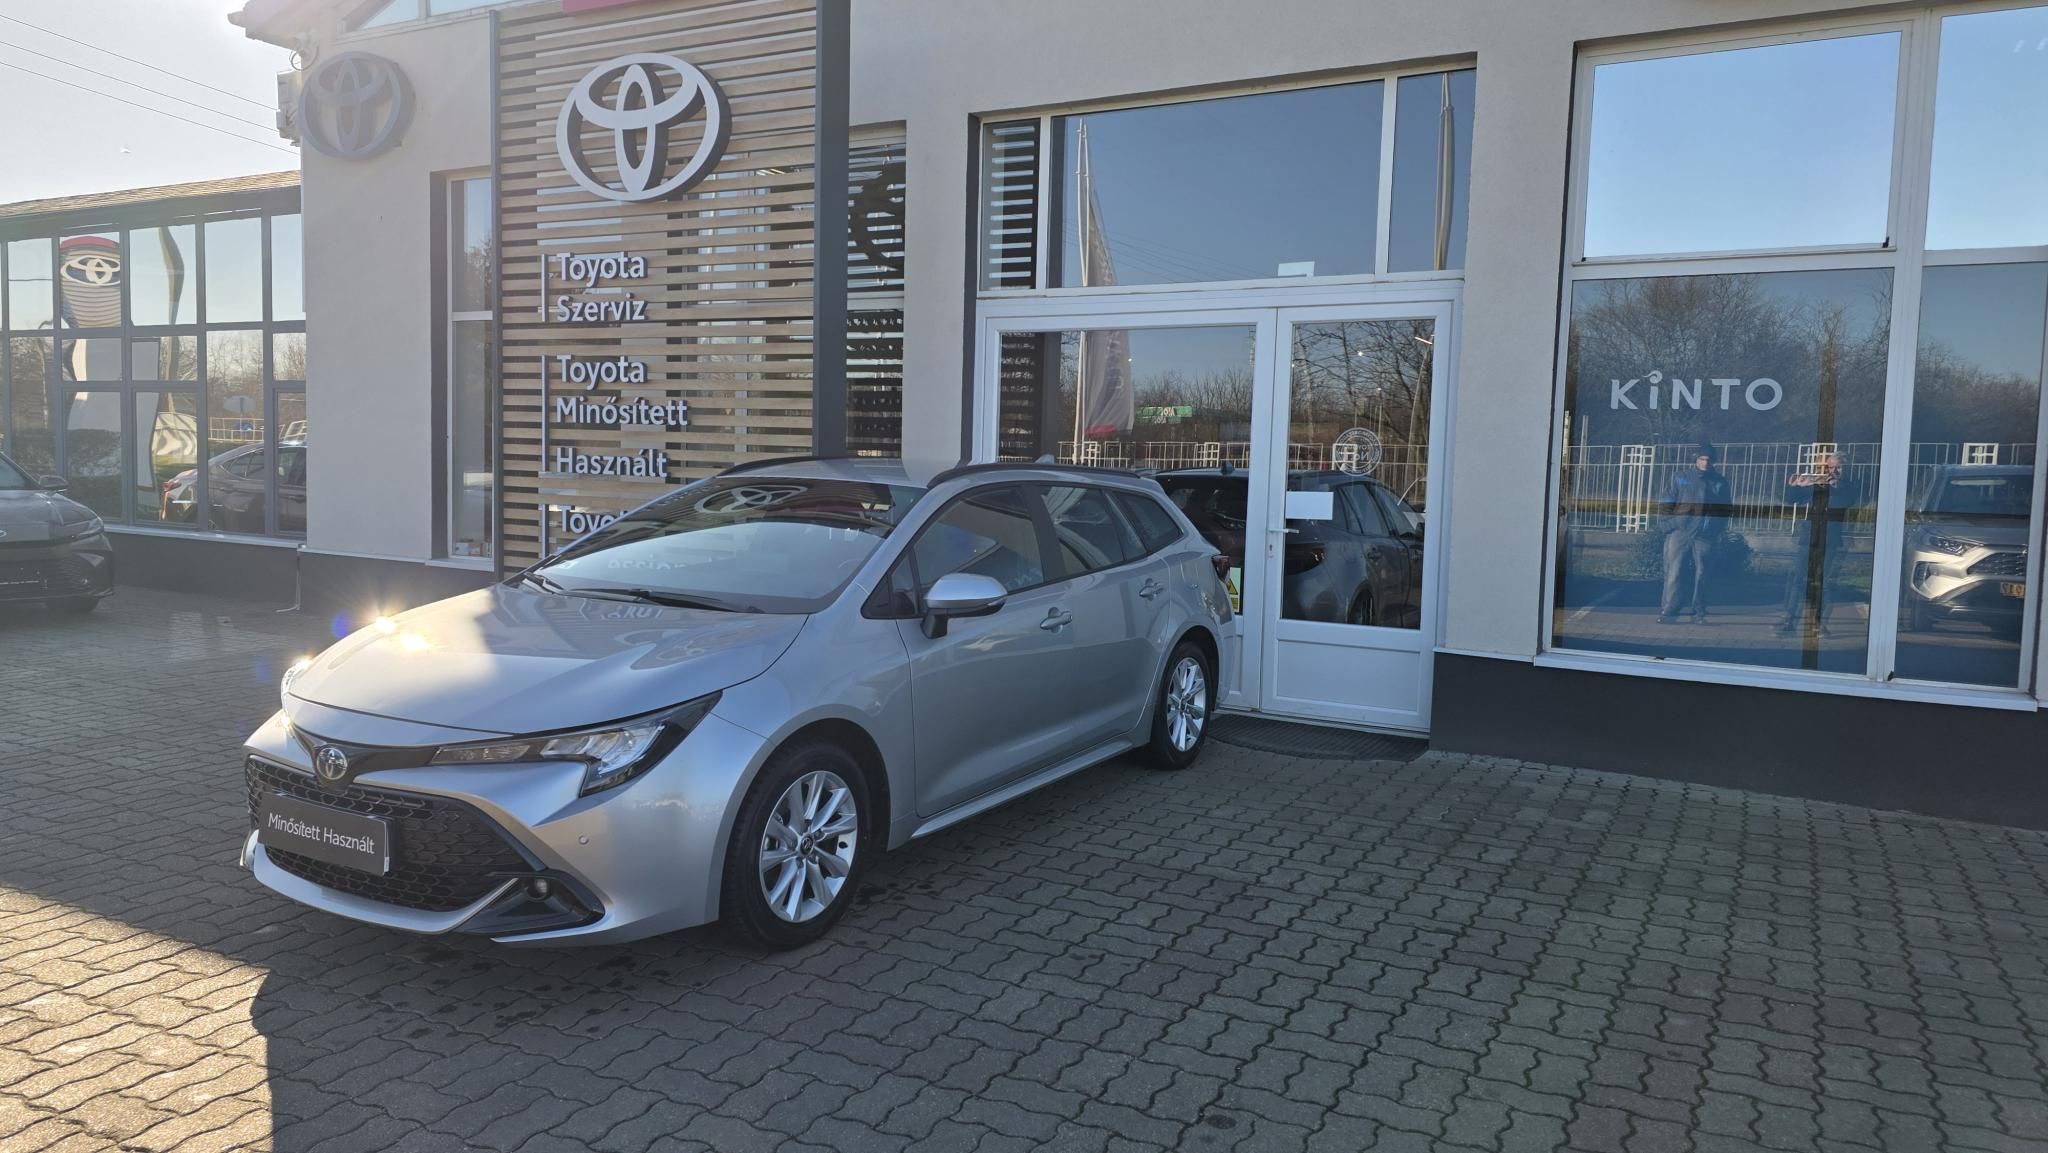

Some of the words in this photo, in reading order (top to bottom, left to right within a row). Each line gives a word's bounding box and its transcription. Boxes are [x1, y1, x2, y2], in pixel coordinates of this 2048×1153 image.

[556, 252, 646, 287] Toyota
[556, 293, 646, 322] Szerviz
[556, 354, 645, 390] Toyota
[556, 396, 688, 426] Minősített
[556, 448, 667, 478] Használt
[268, 812, 321, 841] Minősített
[323, 826, 375, 855] Használt
